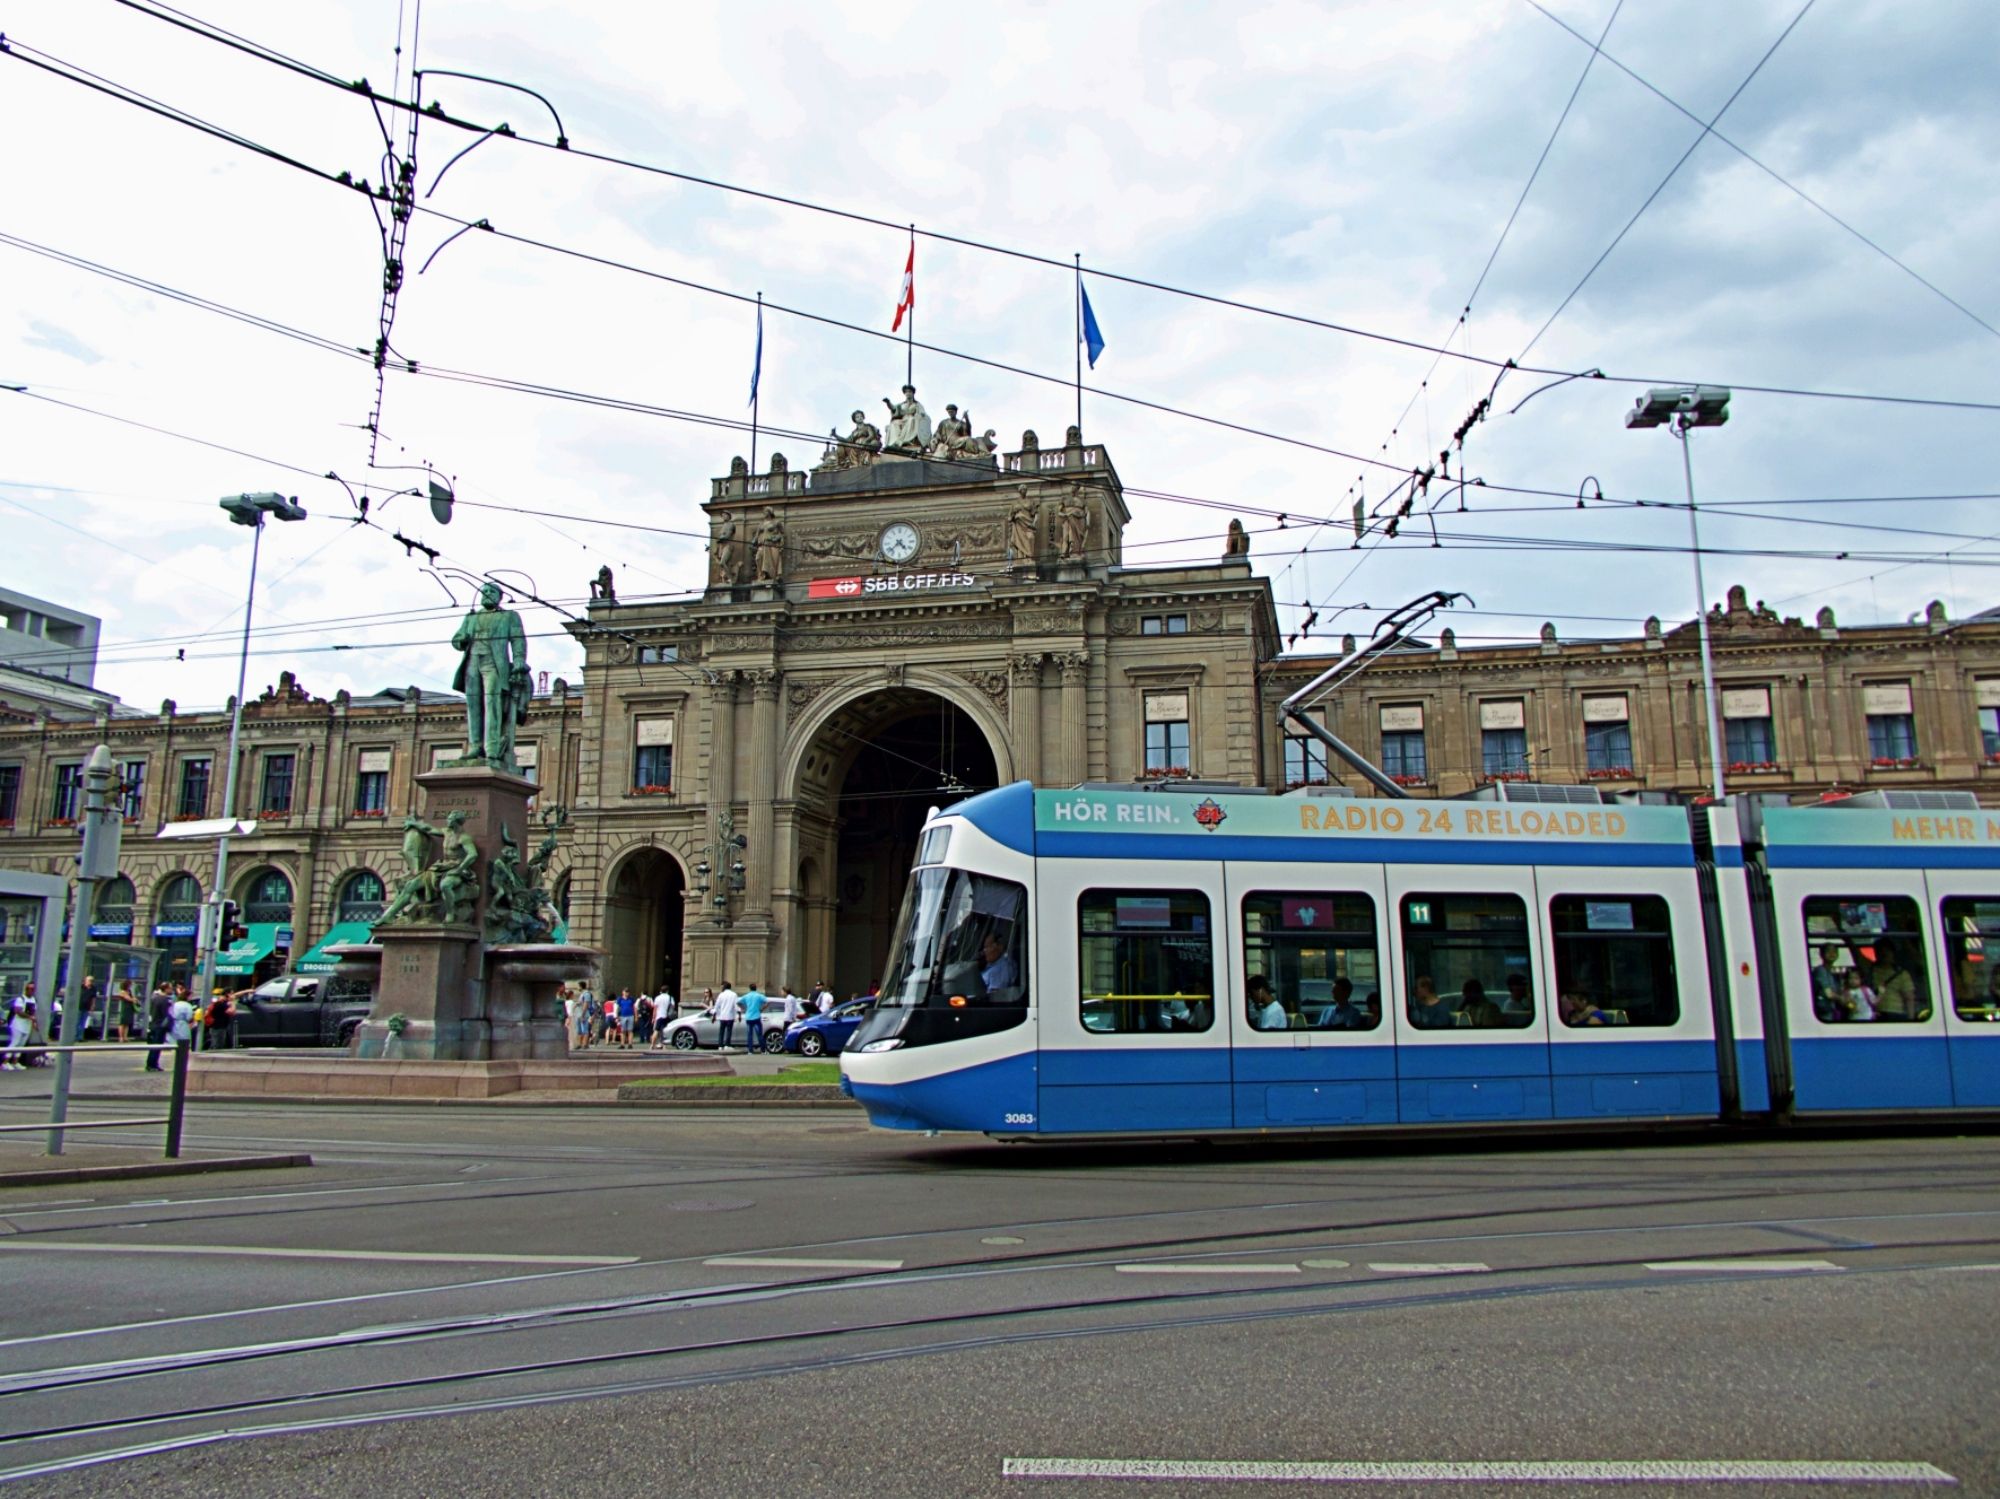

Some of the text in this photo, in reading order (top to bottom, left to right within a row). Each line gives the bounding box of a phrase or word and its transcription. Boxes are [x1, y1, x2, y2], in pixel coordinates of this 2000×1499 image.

[864, 576, 899, 593] SBB
[1055, 797, 1180, 824] HÖR REIN.
[1300, 804, 1626, 836] RADIO 24 RELOADED
[1892, 815, 1977, 841] MEHR
[1412, 905, 1429, 921] 11
[1004, 1113, 1034, 1124] 3083
